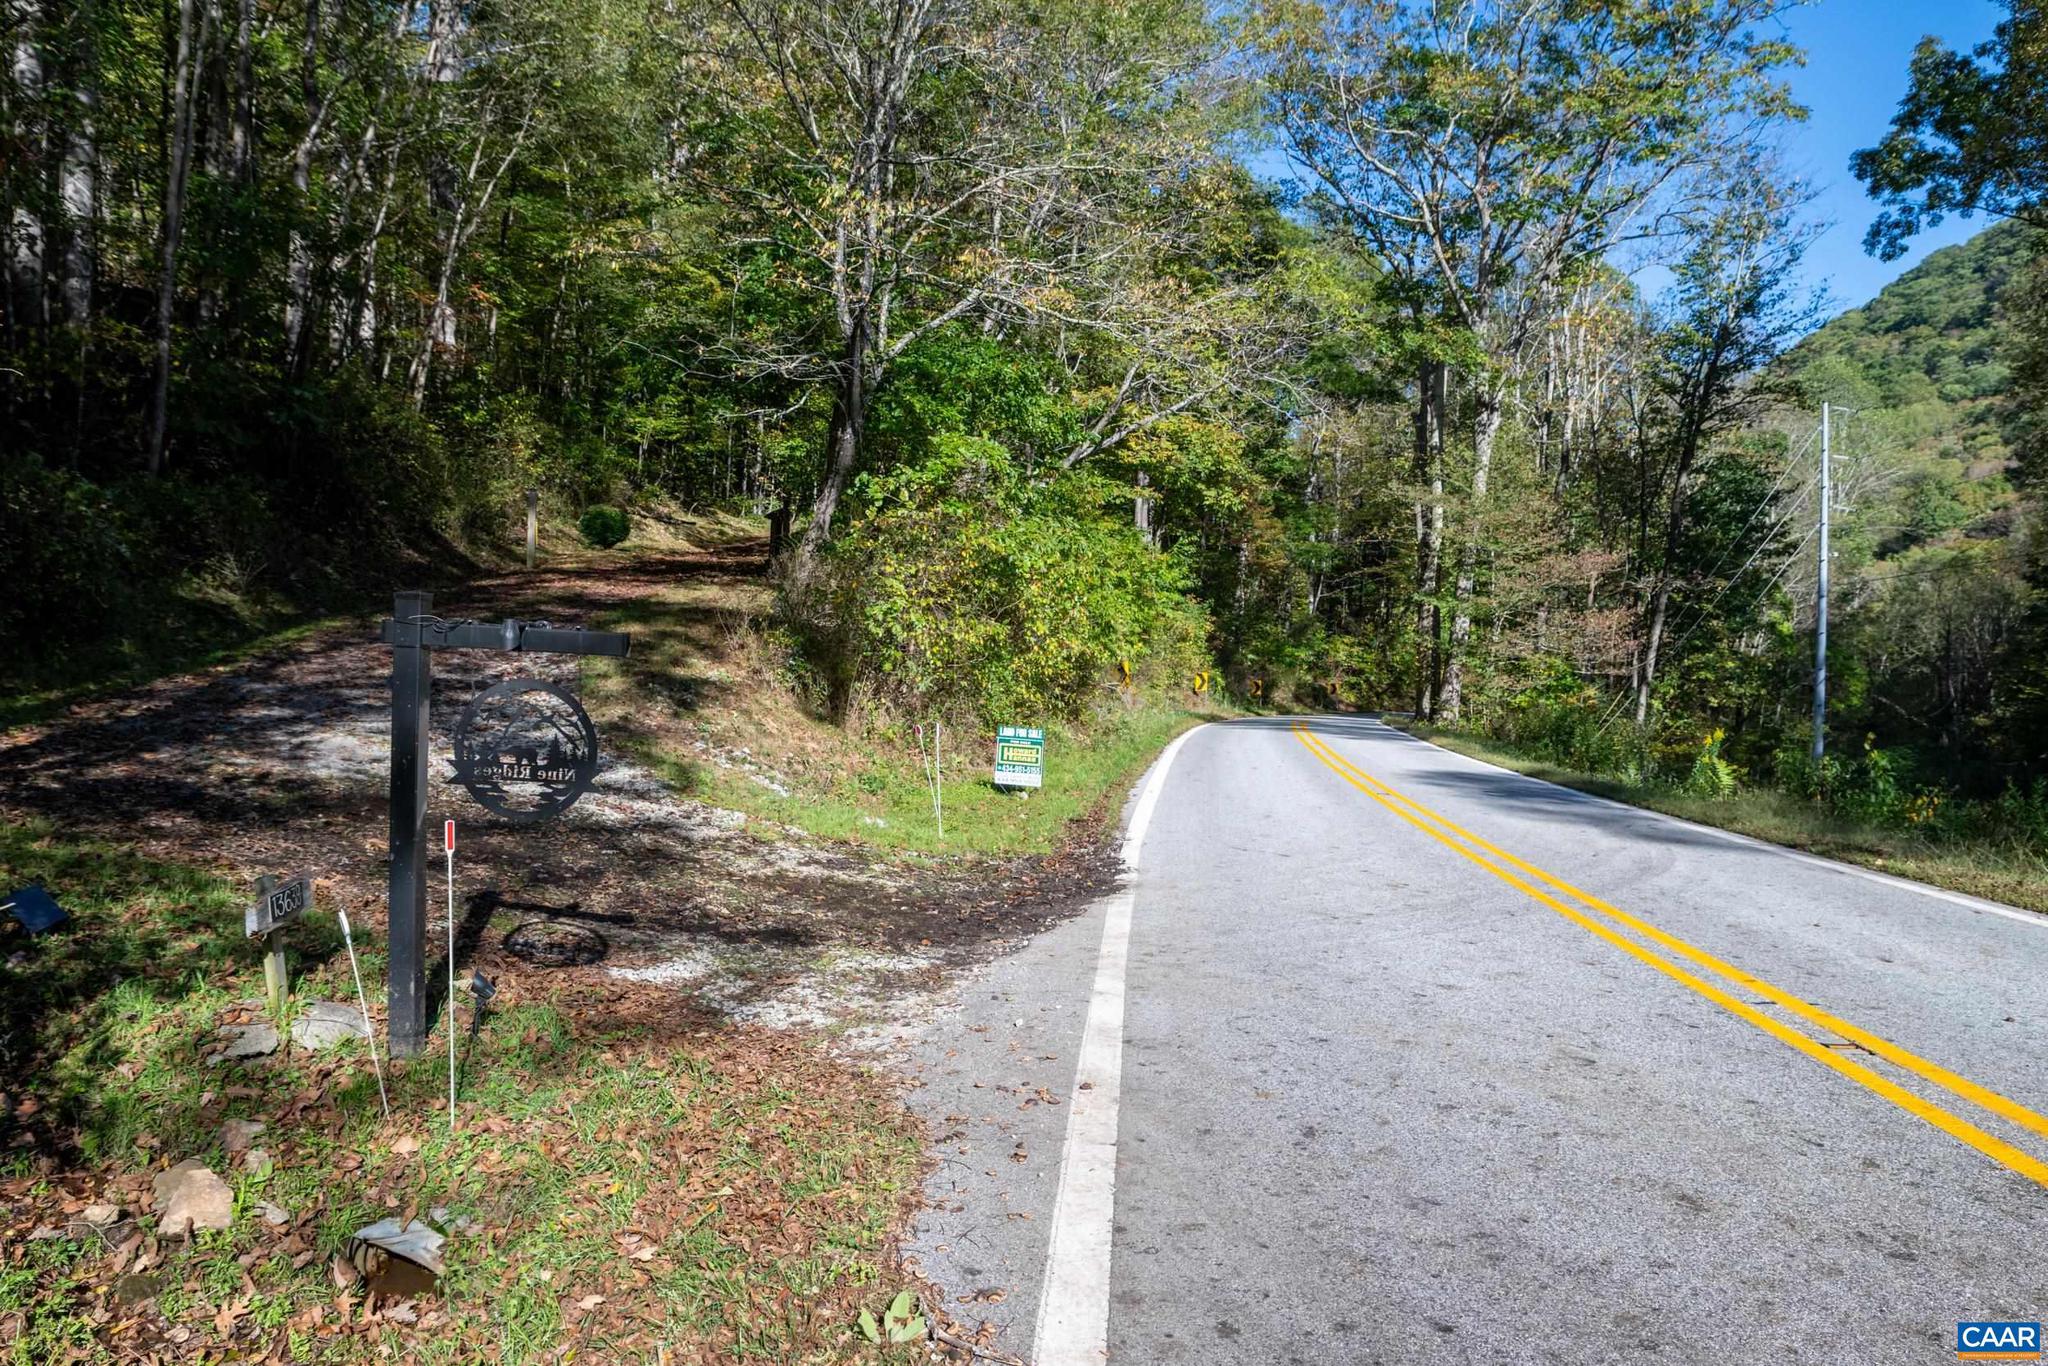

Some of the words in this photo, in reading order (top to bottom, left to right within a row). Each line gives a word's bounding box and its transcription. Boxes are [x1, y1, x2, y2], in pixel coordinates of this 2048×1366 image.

[1000, 726, 1015, 737] LAND
[1015, 728, 1028, 738] FOR
[1028, 728, 1042, 740] SALE
